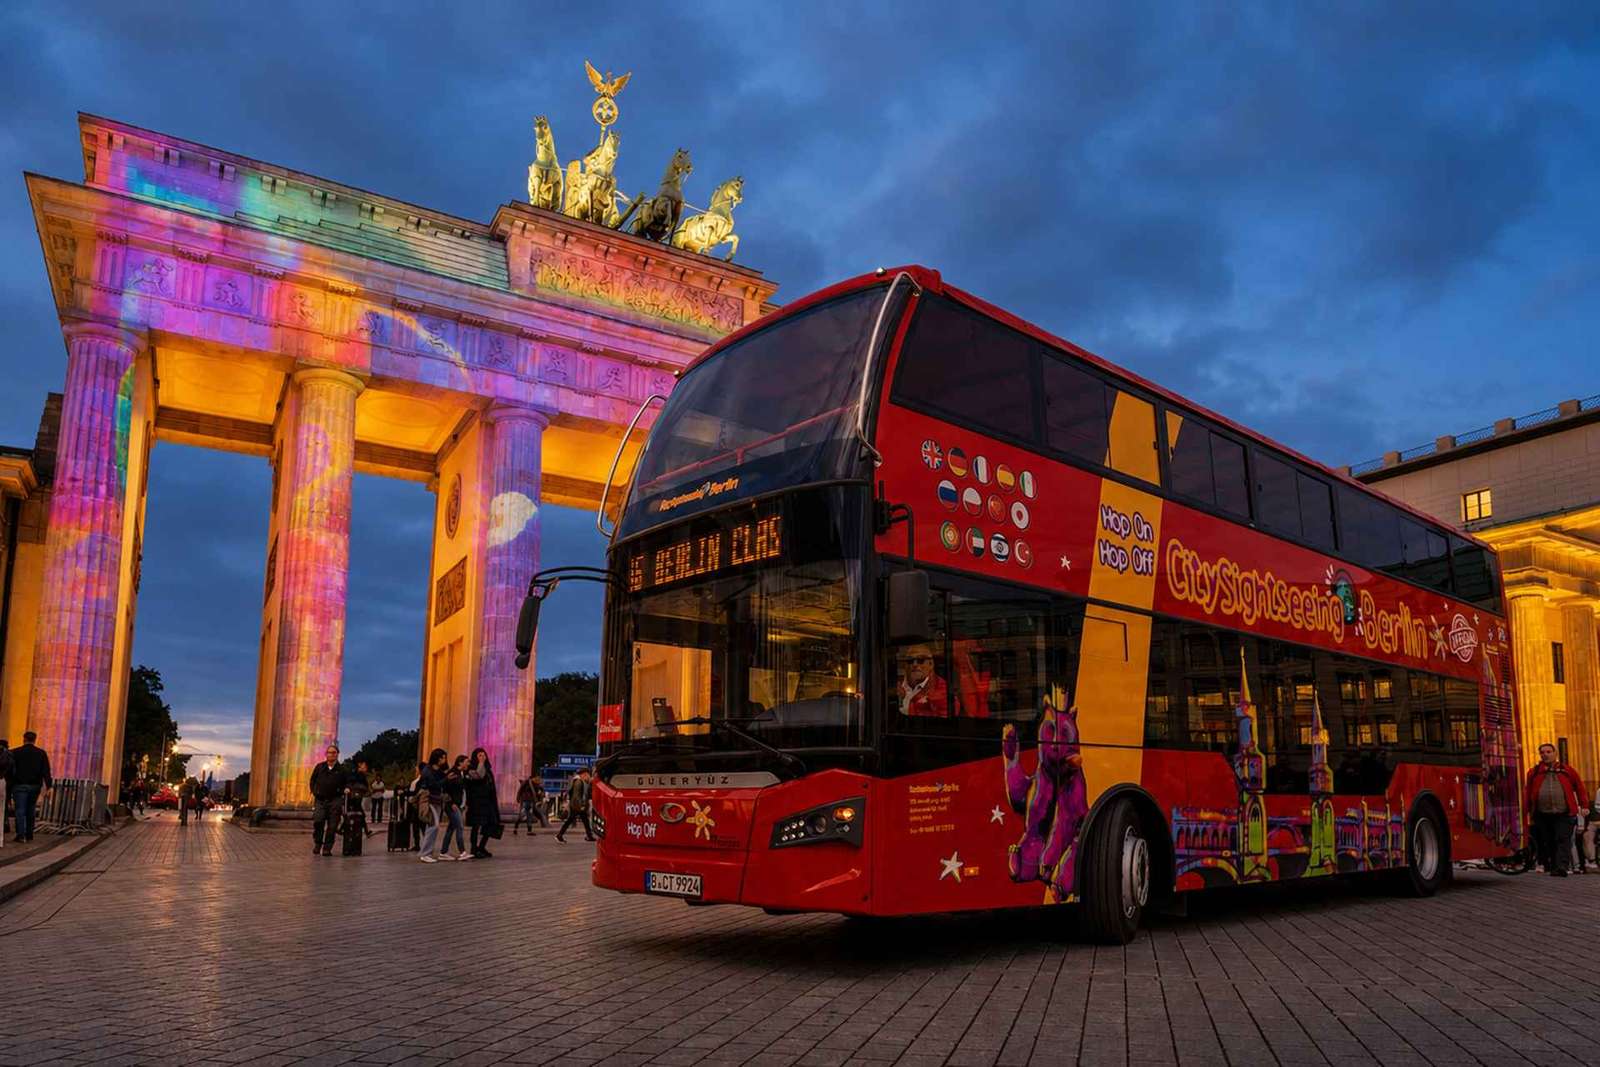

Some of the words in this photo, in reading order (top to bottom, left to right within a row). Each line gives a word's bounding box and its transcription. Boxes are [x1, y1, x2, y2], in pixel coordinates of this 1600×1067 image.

[1101, 504, 1131, 539] Hop
[1133, 511, 1154, 543] On
[655, 532, 721, 585] BERLIN
[730, 514, 782, 566] CLAS
[1098, 538, 1129, 574] Hop
[1131, 545, 1154, 576] Off
[1360, 589, 1428, 659] Berlin
[637, 775, 729, 786] GÜLERYÜZ
[625, 801, 640, 818] Hop
[641, 801, 653, 817] On
[627, 821, 642, 839] Hop
[643, 822, 657, 838] Off
